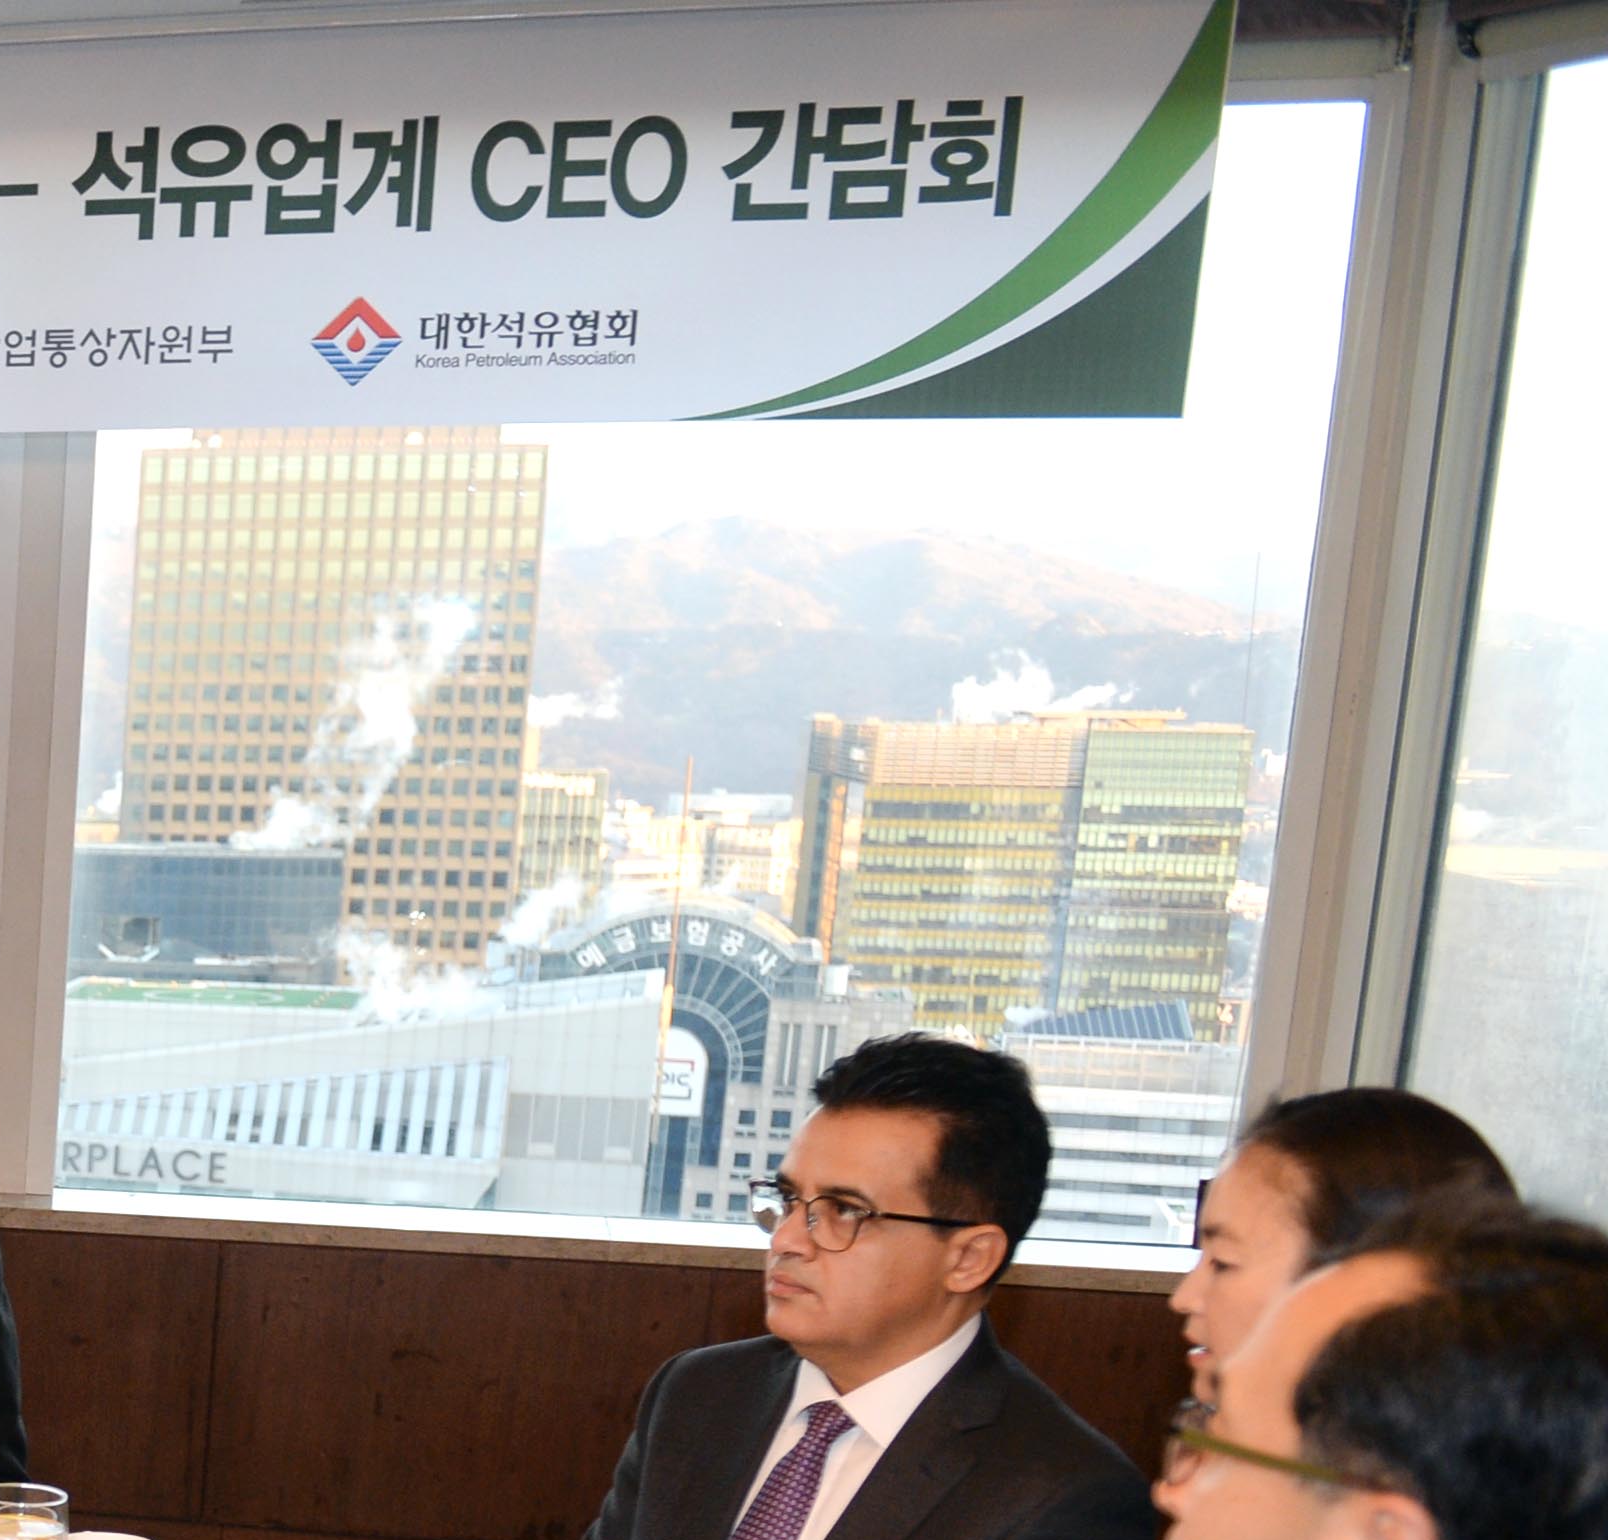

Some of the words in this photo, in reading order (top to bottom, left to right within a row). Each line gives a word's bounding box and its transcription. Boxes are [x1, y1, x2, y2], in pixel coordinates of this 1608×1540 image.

[71, 115, 441, 241] 석유업계
[471, 114, 688, 223] CEO
[721, 95, 1025, 221] 간담회
[419, 309, 639, 350] 대한석유협회
[415, 354, 460, 369] Korea
[464, 349, 543, 368] Petroleum
[546, 346, 636, 366] Association
[575, 918, 779, 977] 예금보험공사
[661, 1071, 690, 1087] DIC
